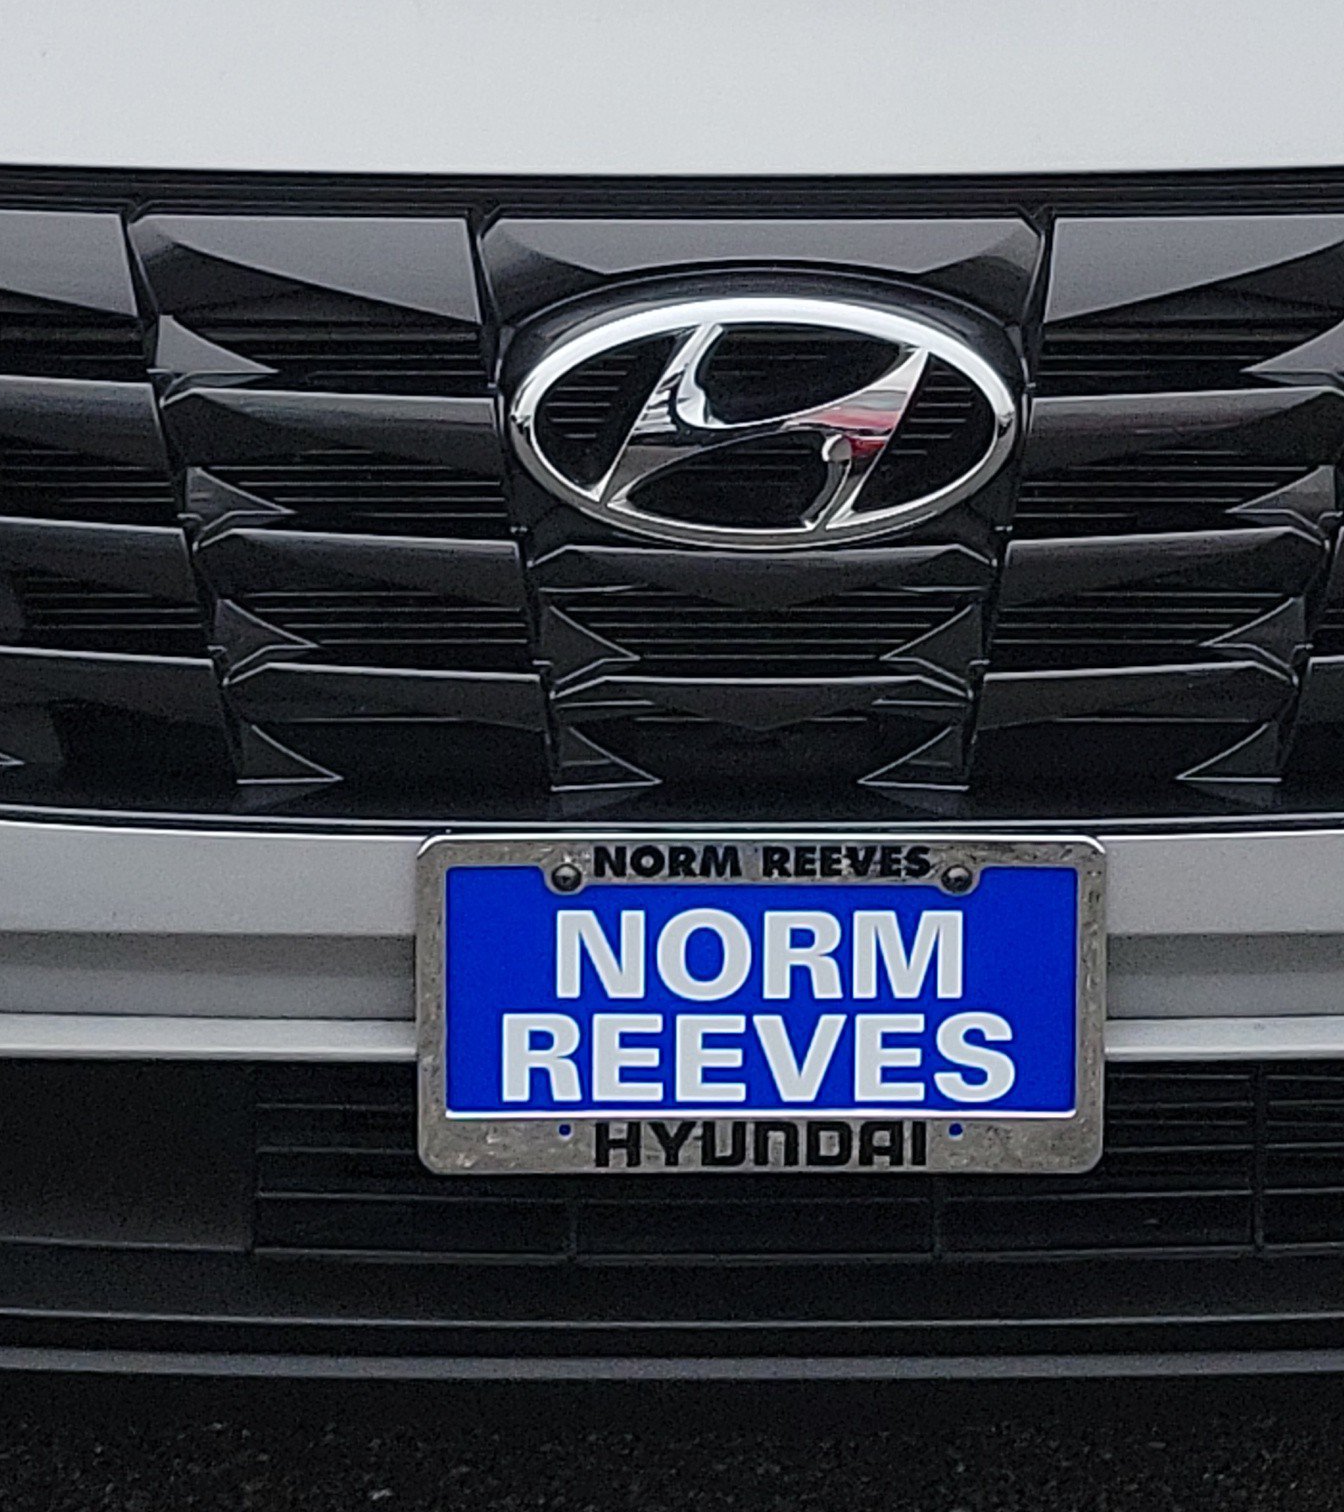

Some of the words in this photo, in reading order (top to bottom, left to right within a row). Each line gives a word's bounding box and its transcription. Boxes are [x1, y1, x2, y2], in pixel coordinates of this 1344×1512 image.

[593, 846, 740, 878] NORM
[762, 846, 932, 878] REEVES
[555, 908, 964, 1001] NORM
[500, 1012, 1017, 1103] REEVES
[594, 1121, 927, 1167] HYUNDAI
